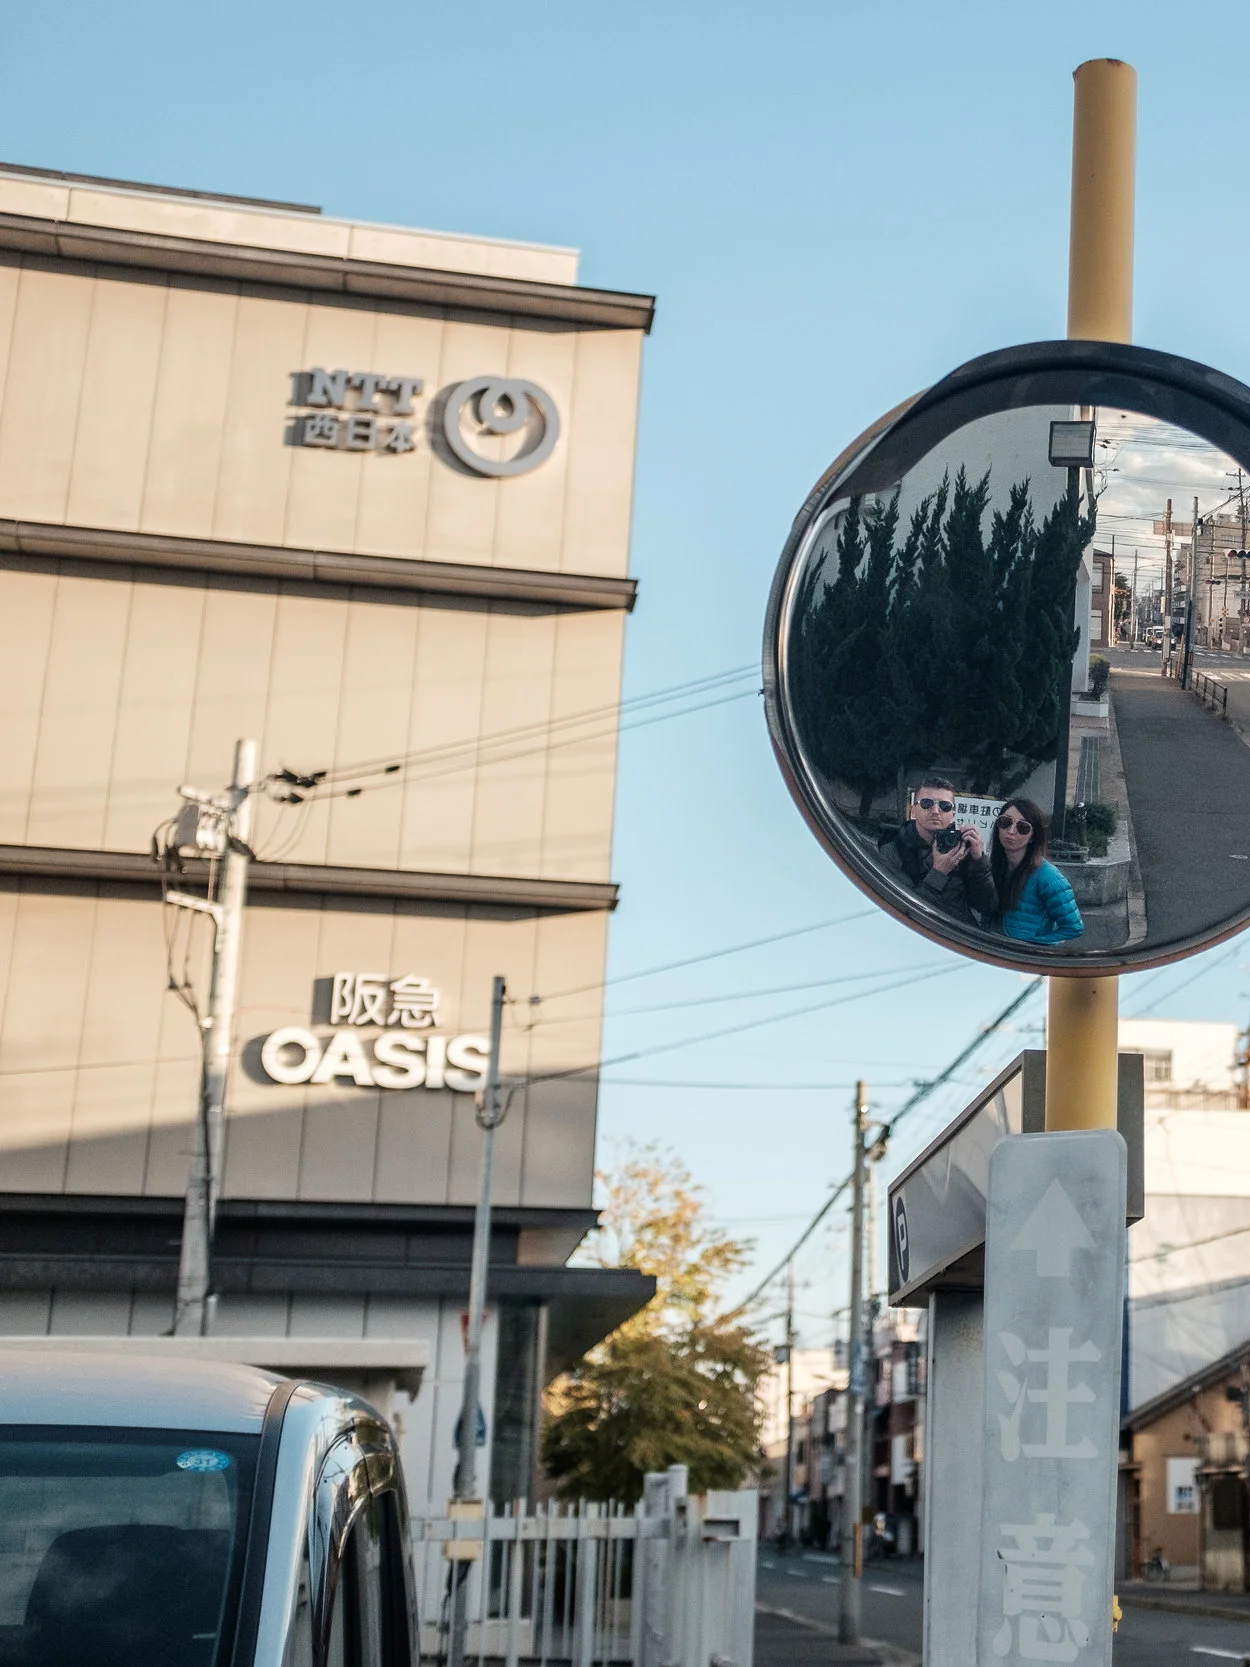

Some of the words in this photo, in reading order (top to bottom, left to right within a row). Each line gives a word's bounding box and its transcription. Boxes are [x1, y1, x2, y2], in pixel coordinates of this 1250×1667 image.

[307, 368, 424, 416] NTT
[303, 412, 417, 454] 西日本
[330, 970, 441, 1029] 阪急
[261, 1026, 491, 1093] OASIS
[993, 1327, 1102, 1664] 注意
